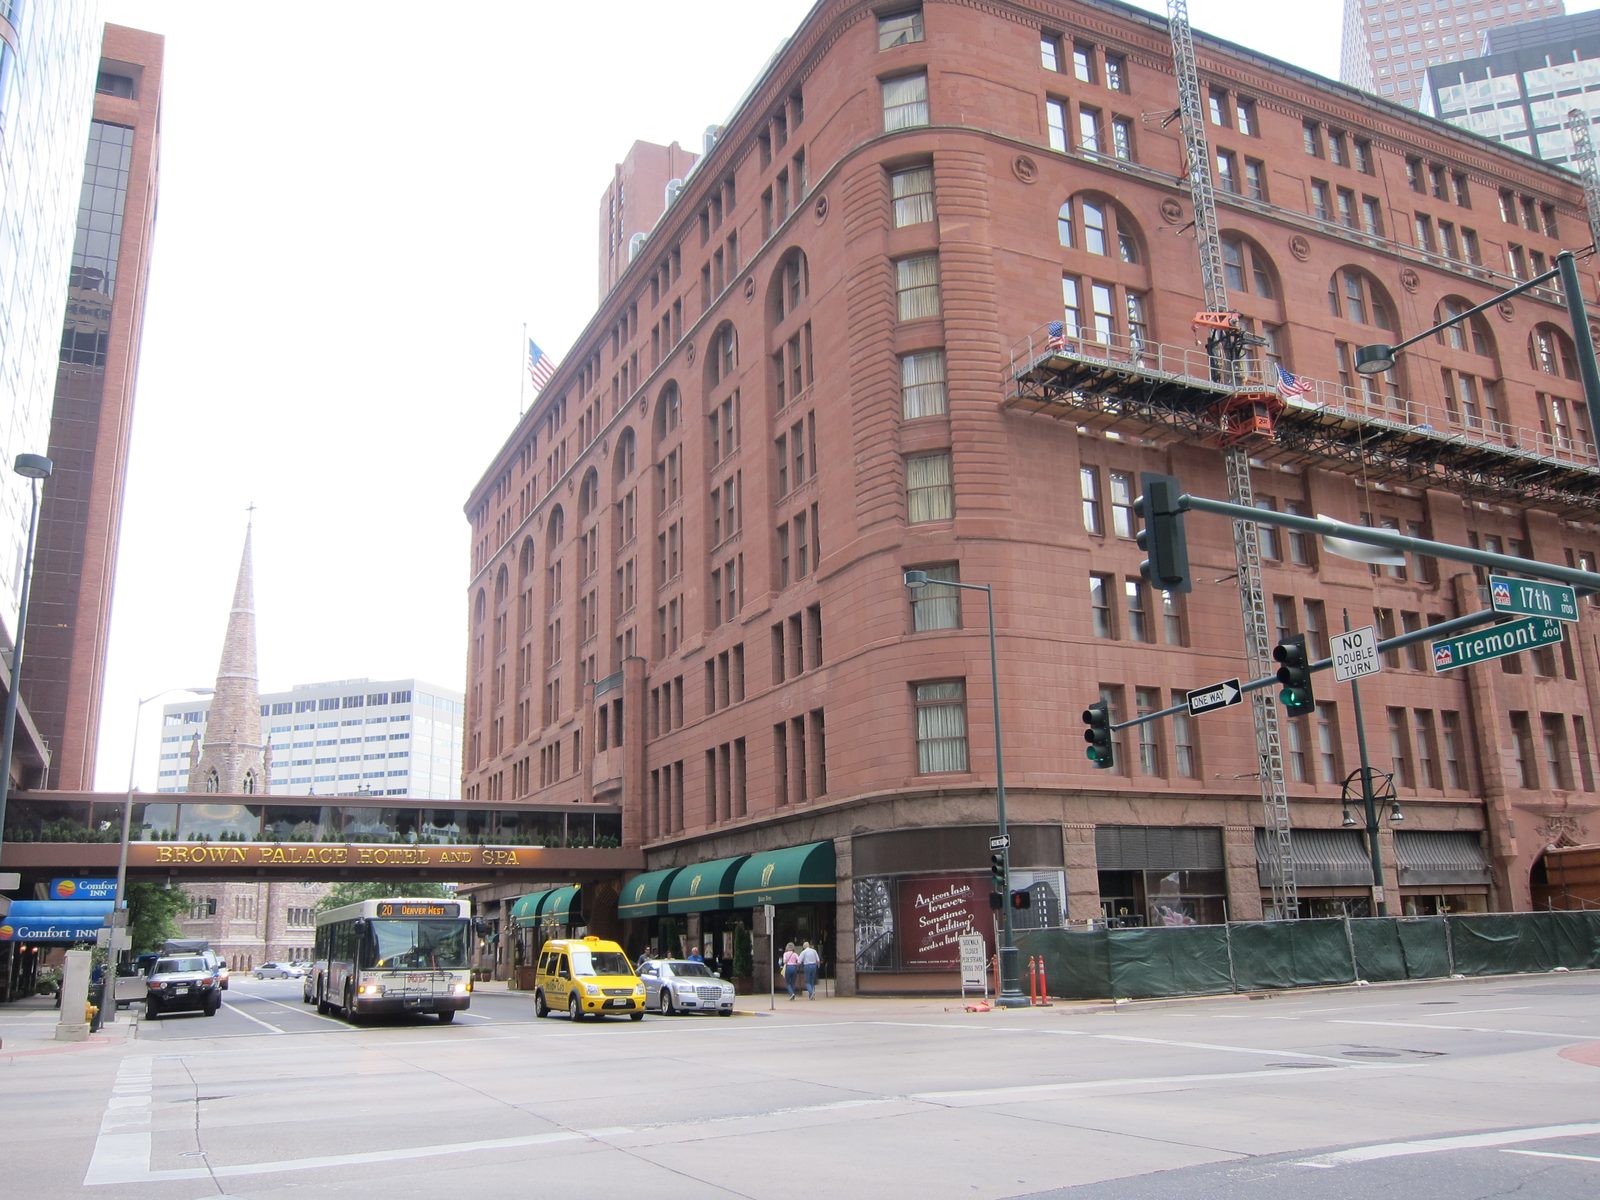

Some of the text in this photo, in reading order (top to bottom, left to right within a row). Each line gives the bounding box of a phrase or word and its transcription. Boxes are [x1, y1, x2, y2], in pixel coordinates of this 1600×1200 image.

[1520, 586, 1569, 611] 17th St
[1542, 627, 1559, 638] 400
[1342, 634, 1362, 650] NO
[1455, 622, 1537, 660] Tremont
[1337, 647, 1374, 665] DOUBLE
[1344, 661, 1371, 676] TURN
[1193, 690, 1225, 707] ONE WAY
[156, 846, 520, 865] BROWN PALACE HOTEL AND SPA
[79, 880, 117, 890] Comfort
[915, 884, 970, 908] An icon lasts
[382, 904, 393, 915] 20
[919, 908, 967, 928] Sometimes
[17, 926, 98, 938] Comfort INN
[919, 941, 939, 953] needs
